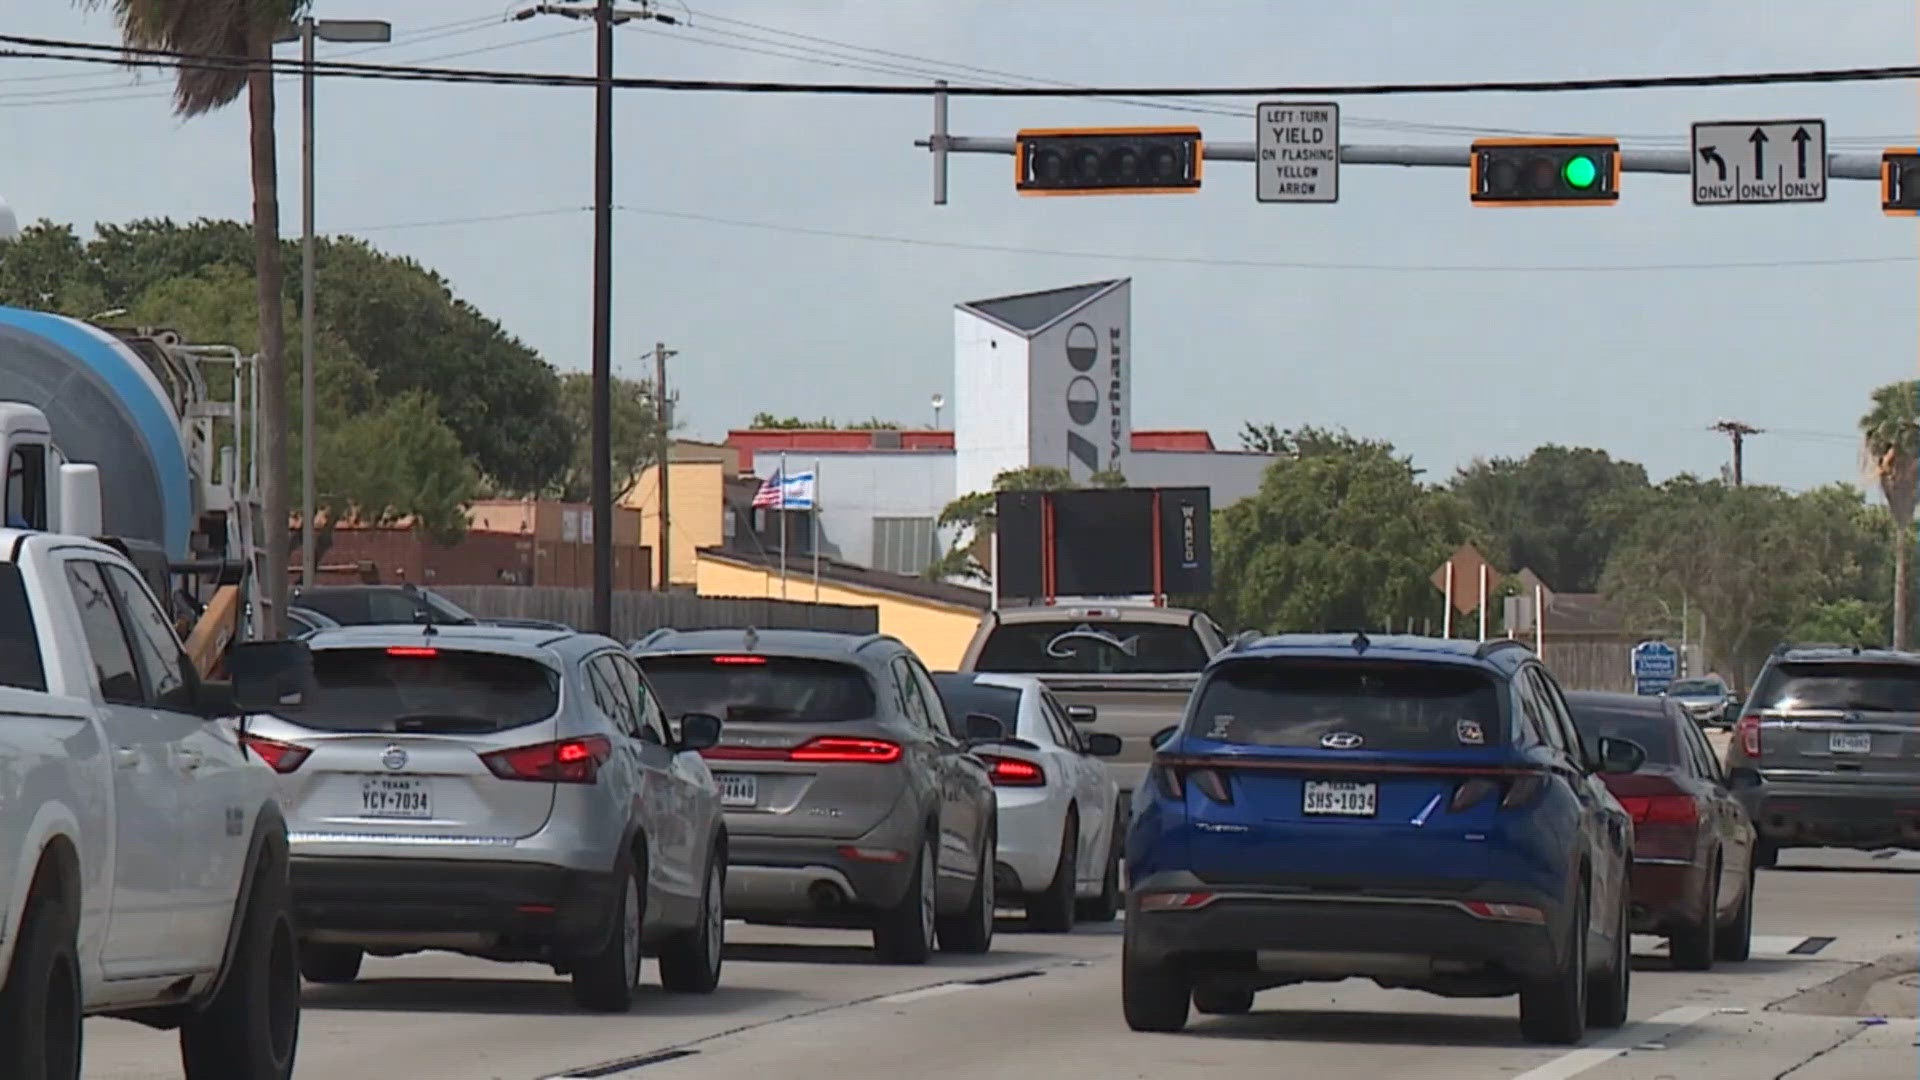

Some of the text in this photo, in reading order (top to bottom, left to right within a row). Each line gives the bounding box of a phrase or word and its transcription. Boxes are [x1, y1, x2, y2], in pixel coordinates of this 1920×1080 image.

[1267, 111, 1328, 122] LEFT TURN
[1272, 127, 1323, 143] YIELD
[1261, 149, 1334, 160] ON FLASHING
[1277, 167, 1318, 178] YELLOW
[1279, 183, 1316, 194] ARROW
[1699, 186, 1733, 199] ONLY
[1741, 184, 1776, 198] ONLY
[1784, 183, 1819, 197] ONLY
[1182, 506, 1194, 561] WANCO
